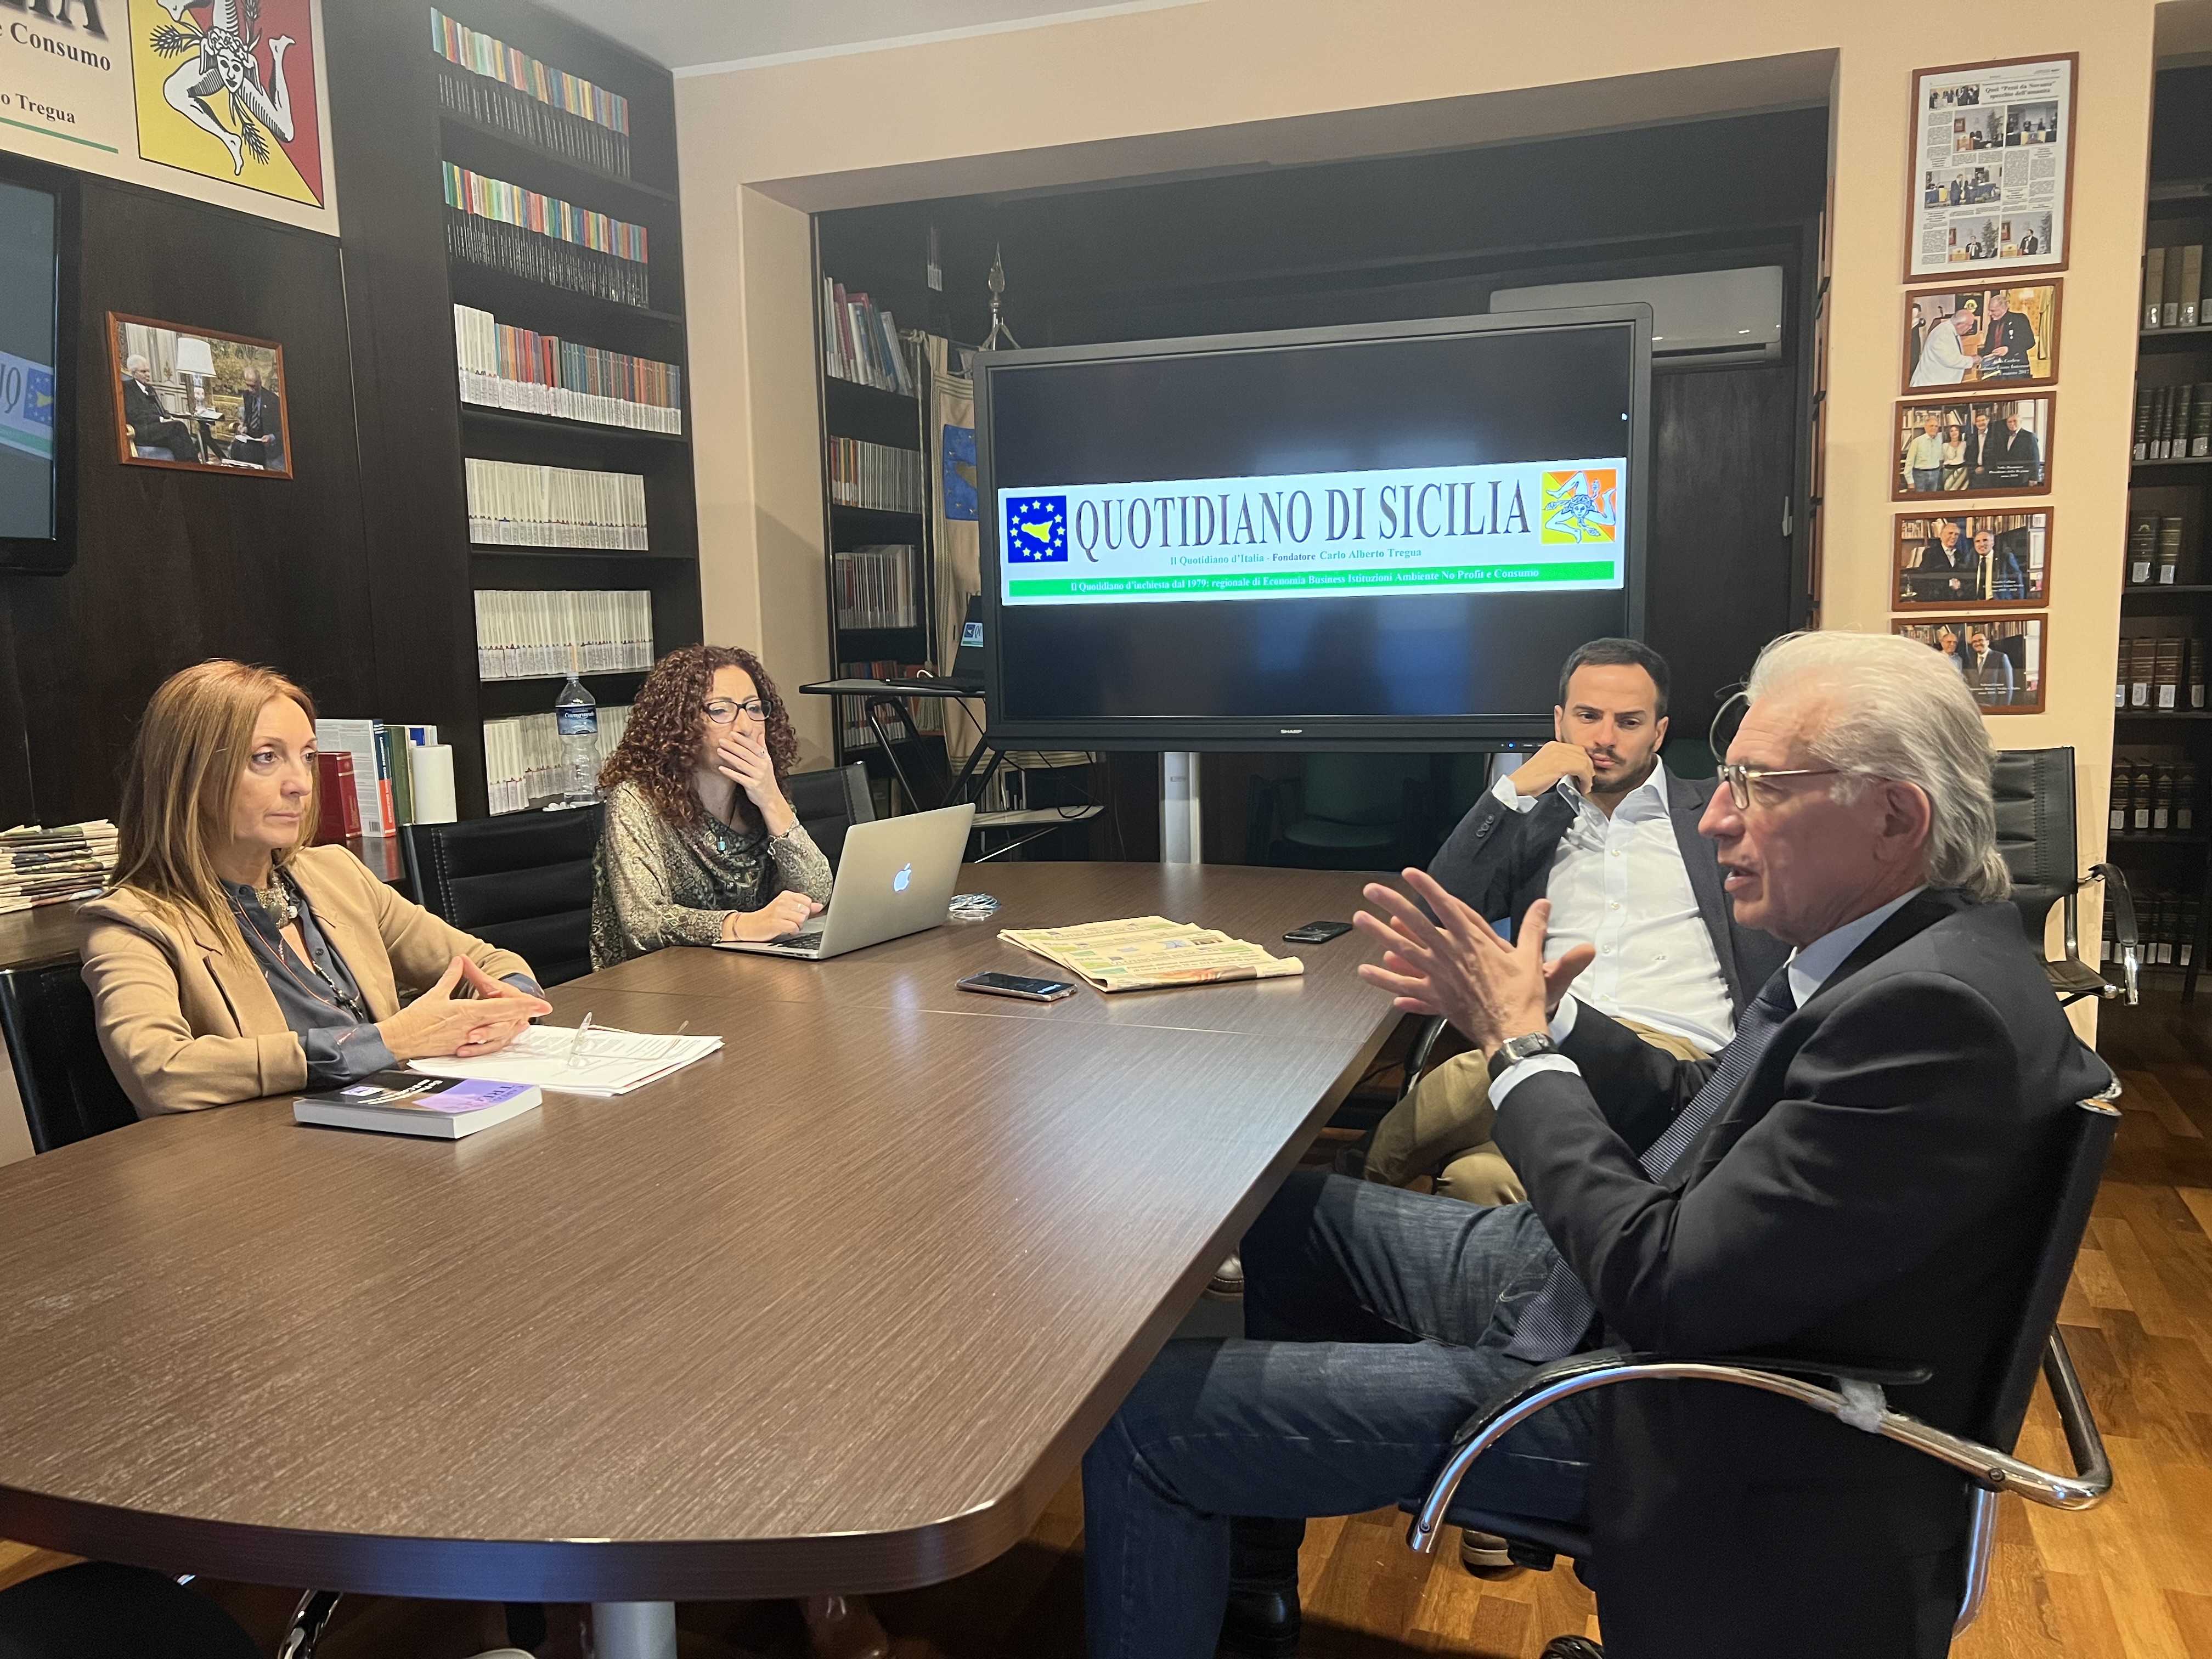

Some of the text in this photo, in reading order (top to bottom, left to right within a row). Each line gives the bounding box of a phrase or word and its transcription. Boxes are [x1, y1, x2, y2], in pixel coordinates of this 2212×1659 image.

[10, 22, 110, 71] Consumo
[15, 93, 75, 124] Tregua
[1075, 479, 1531, 562] QUOTIDIANO DI SICILIA
[1171, 557, 1177, 565] Il
[1180, 556, 1228, 566] Quotidiano
[1231, 554, 1264, 563] d'Italia
[1273, 553, 1316, 562] Fondatore
[1319, 550, 1345, 560] Carlo
[1348, 550, 1384, 559] Alberto
[1387, 549, 1421, 558] Tregua
[1071, 583, 1077, 591] Il
[1079, 582, 1124, 592] Quotidiano
[1126, 580, 1170, 590] d'inchiesta
[1171, 579, 1185, 589] dal
[1212, 577, 1250, 590] regionale
[1252, 577, 1260, 586] di
[1263, 577, 1305, 586] Economia
[1308, 575, 1344, 584] Business
[1348, 573, 1392, 583] Istituzioni
[1395, 572, 1438, 582] Ambiente
[1441, 571, 1455, 580] No
[1458, 569, 1484, 579] Profit
[1494, 568, 1539, 578] Consumo
